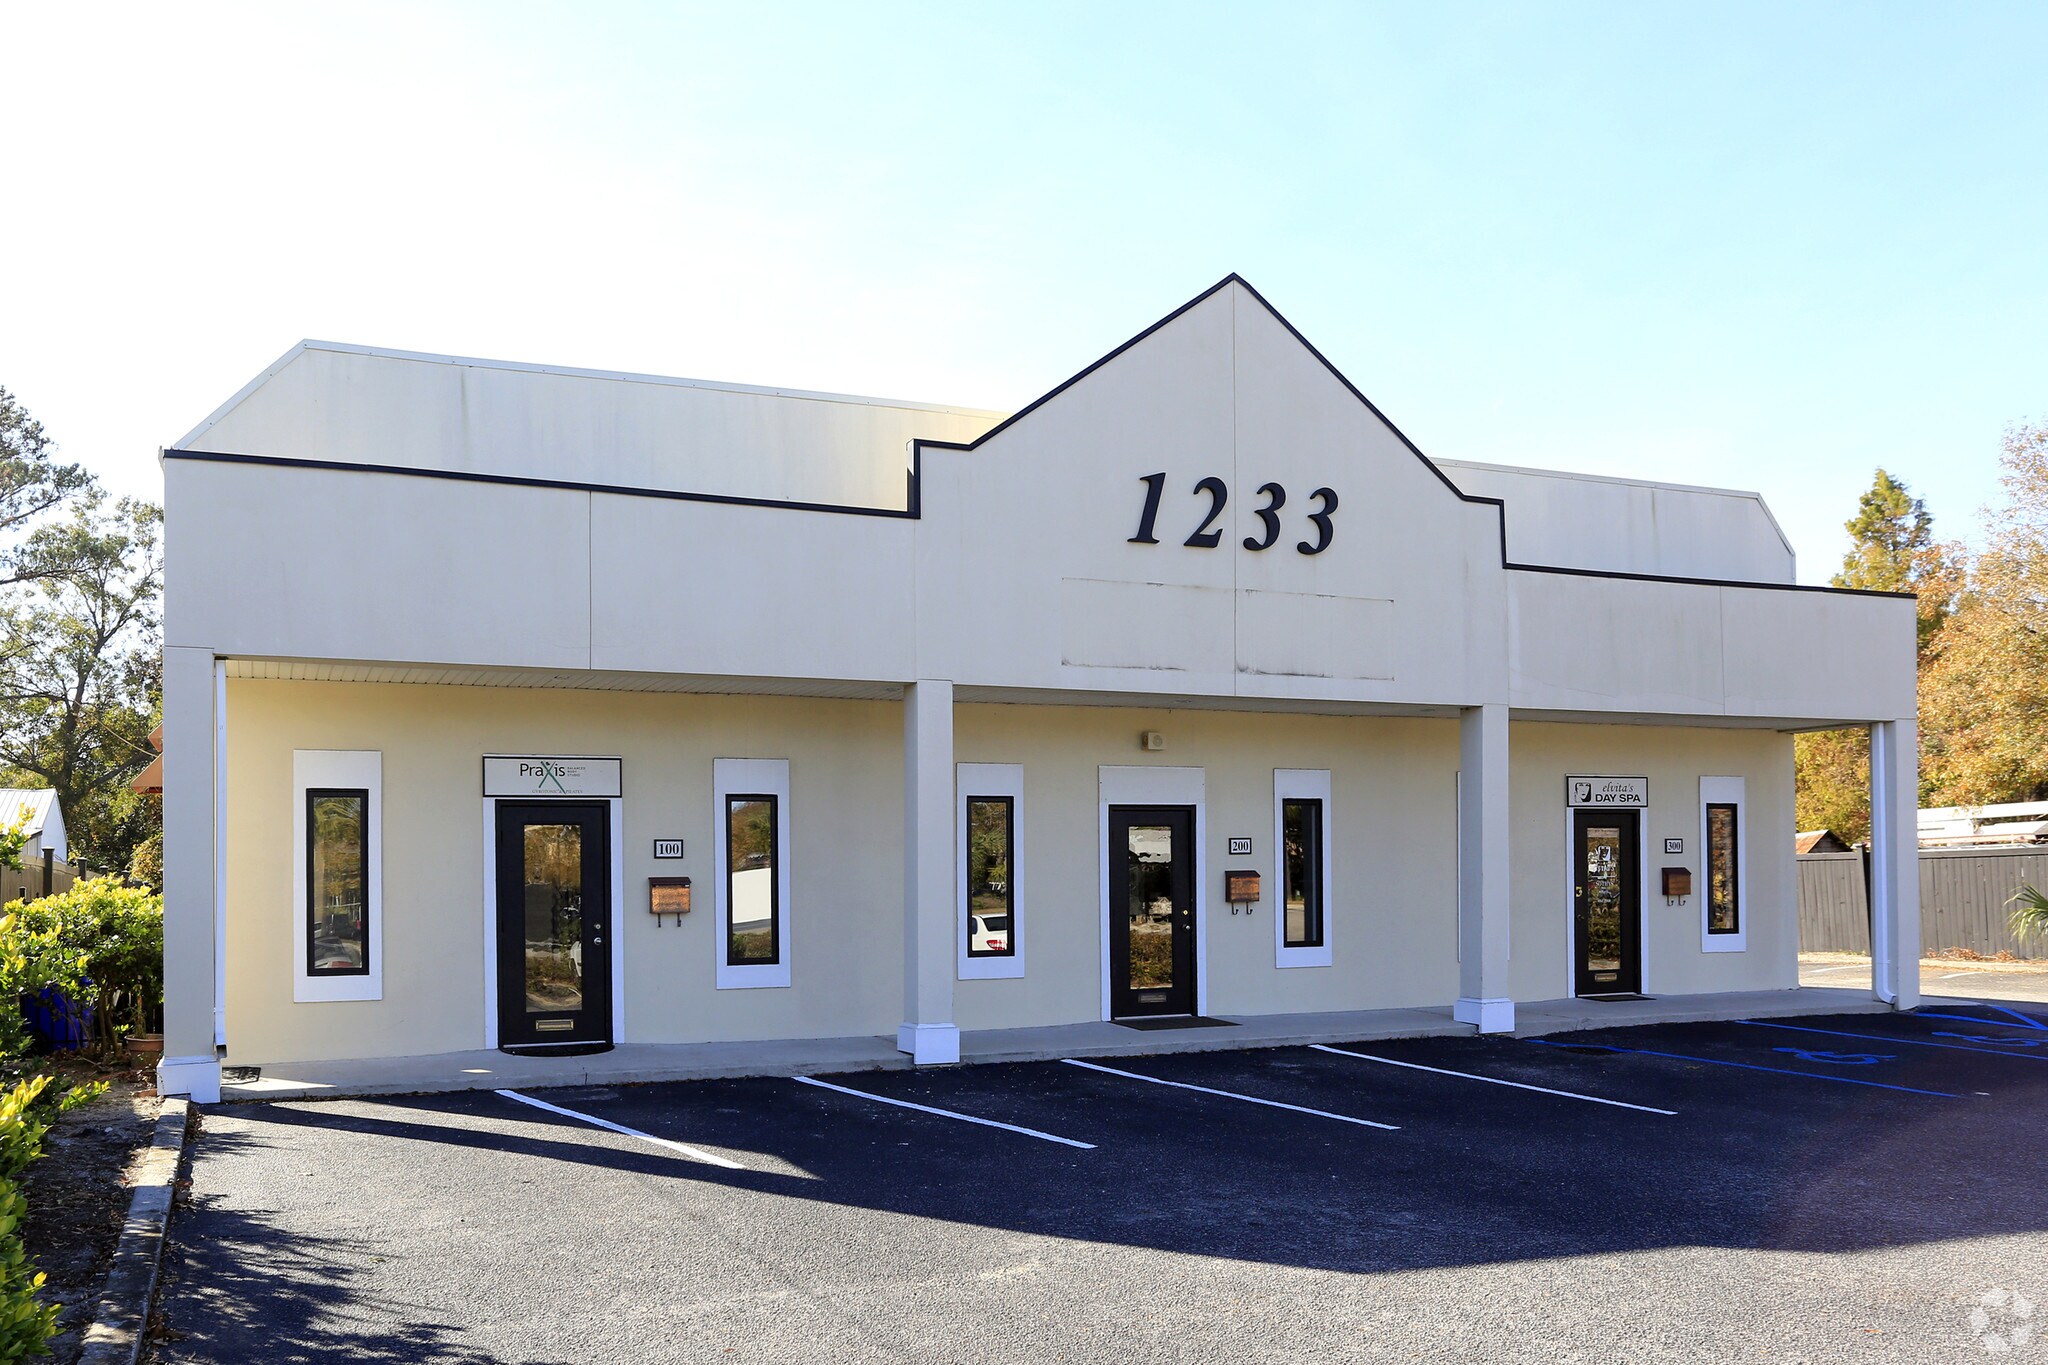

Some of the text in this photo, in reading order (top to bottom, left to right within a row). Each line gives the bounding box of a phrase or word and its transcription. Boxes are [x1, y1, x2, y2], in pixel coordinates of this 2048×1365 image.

[1127, 471, 1339, 555] 1233
[1595, 793, 1641, 803] DAY SPA
[659, 843, 680, 855] 100
[1232, 840, 1249, 852] 200
[1667, 841, 1681, 851] 300
